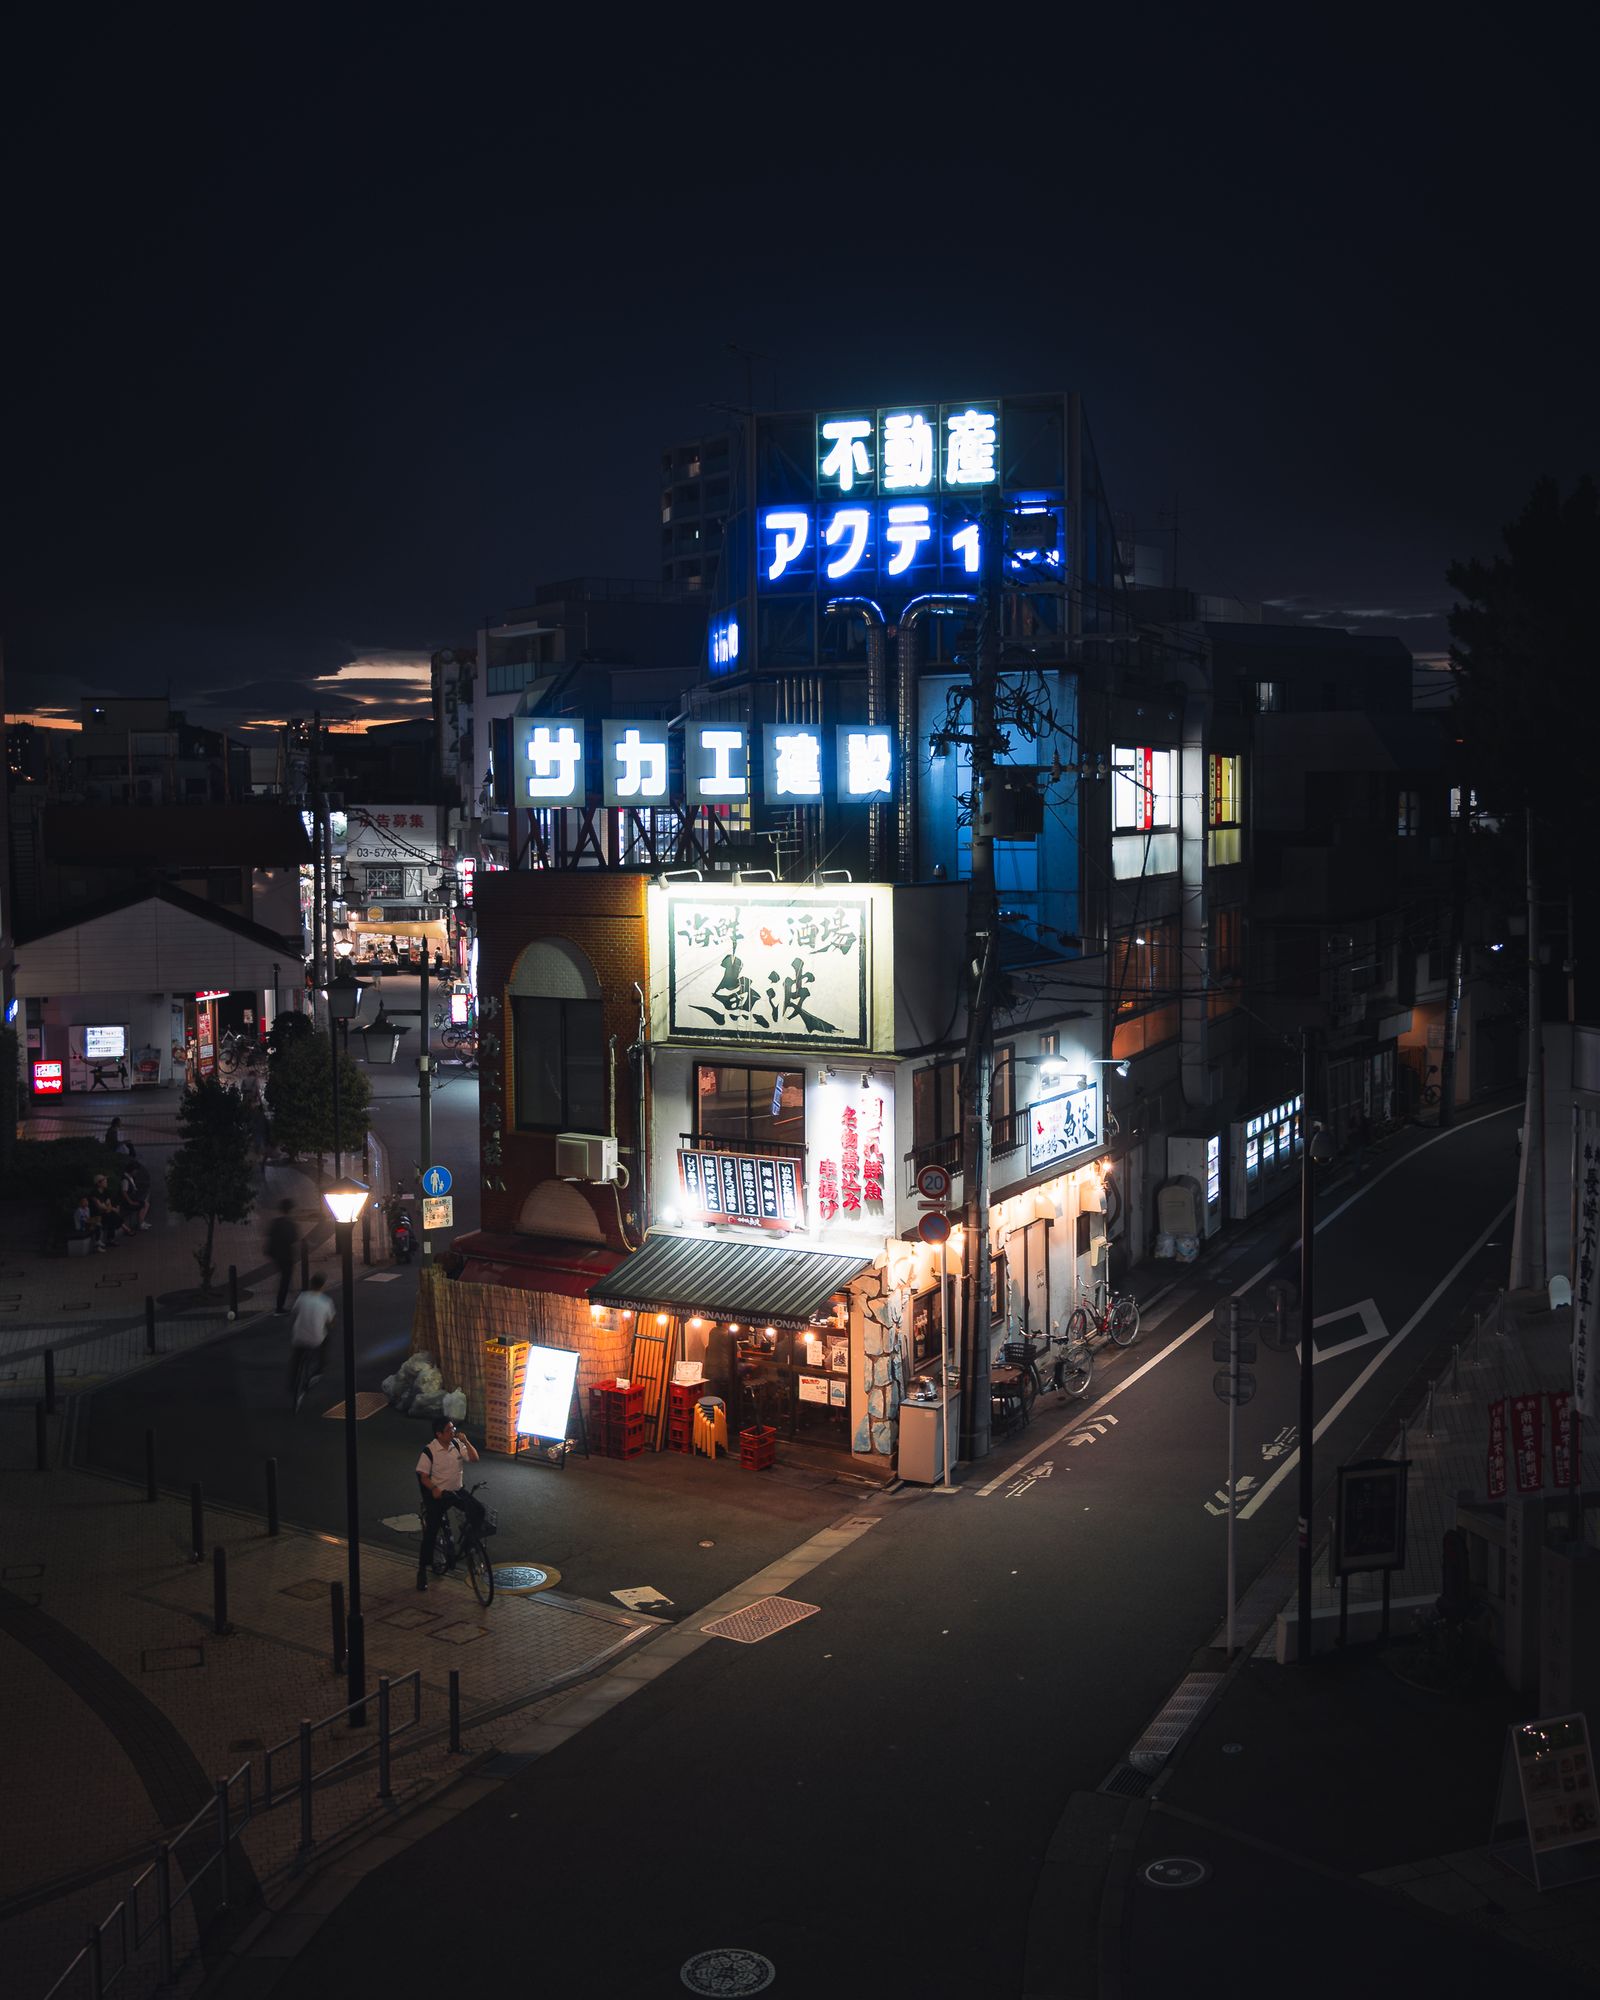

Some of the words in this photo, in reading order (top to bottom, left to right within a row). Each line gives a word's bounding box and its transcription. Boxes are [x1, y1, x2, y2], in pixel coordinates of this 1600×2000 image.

[823, 409, 996, 491] 不動産
[765, 499, 1061, 580] アクティ
[677, 906, 745, 956] 海鮮
[787, 907, 857, 955] 酒場
[688, 954, 845, 1034] 魚波
[1057, 1096, 1097, 1150] 魚波
[924, 1175, 944, 1190] 20
